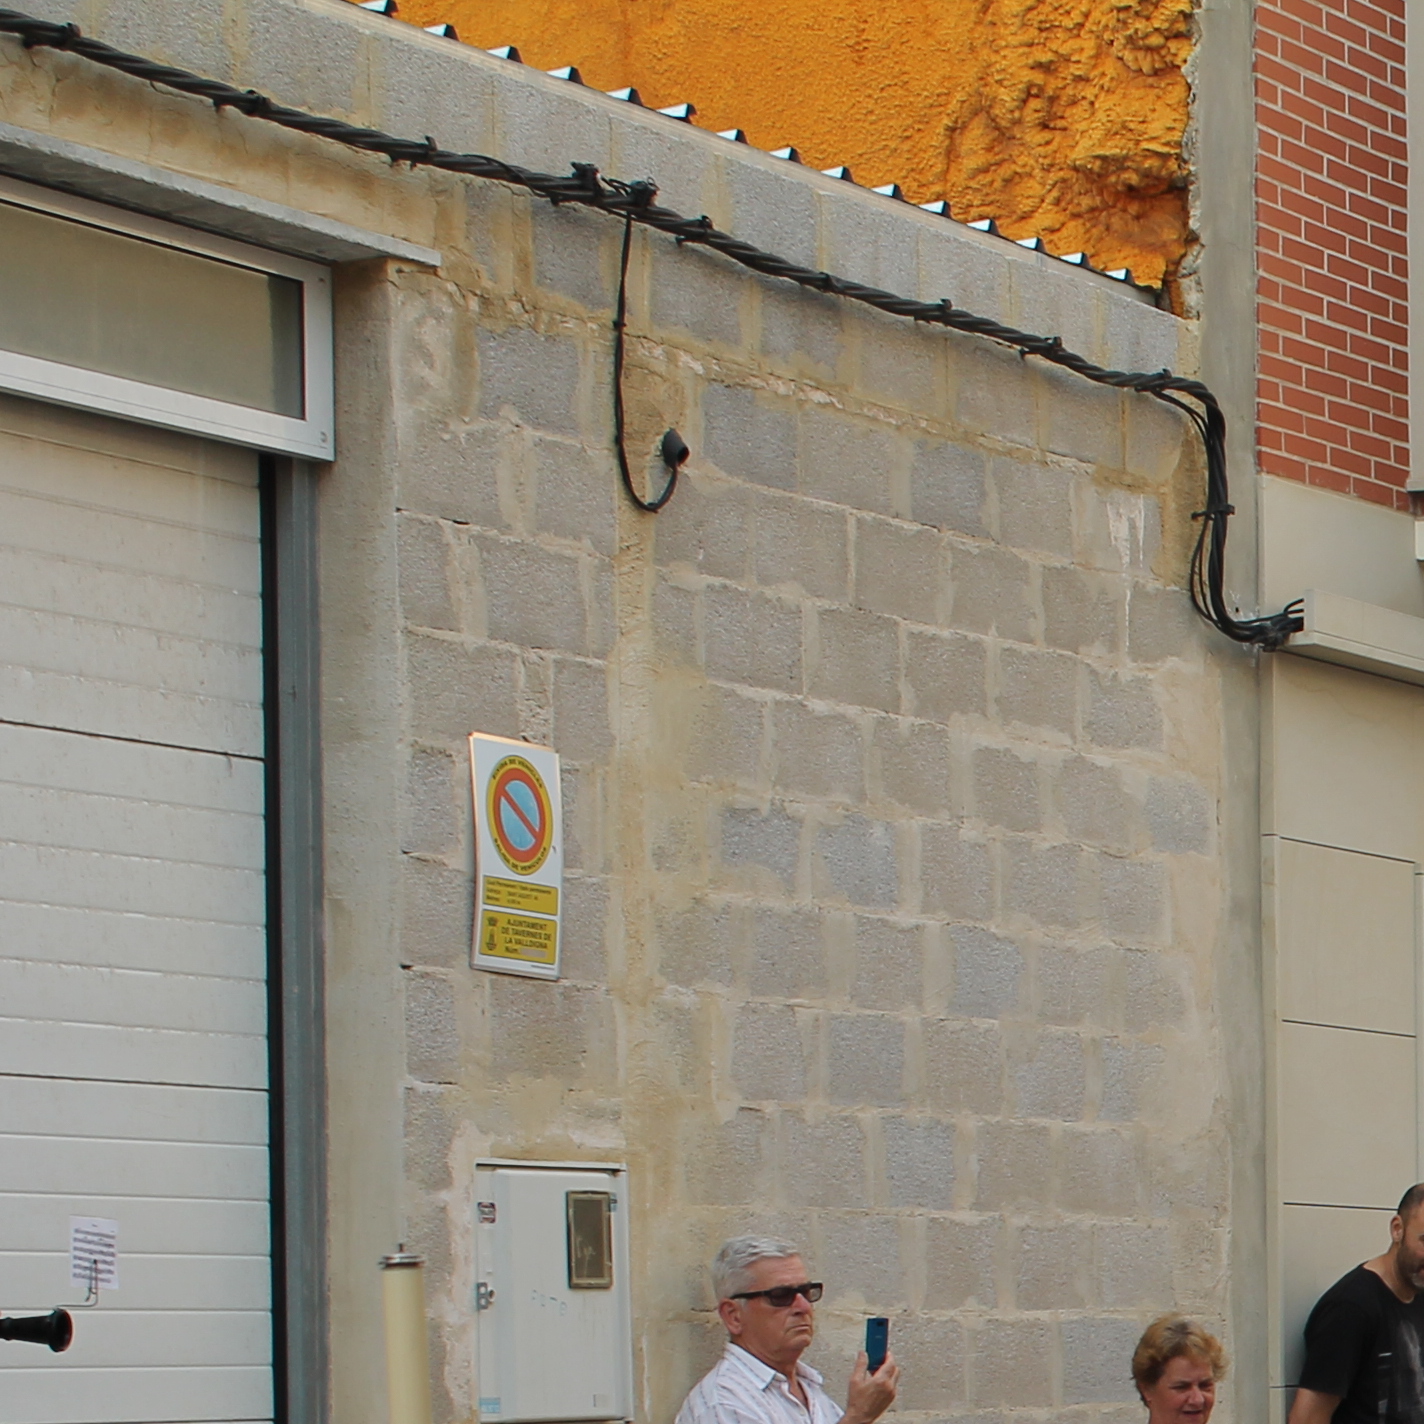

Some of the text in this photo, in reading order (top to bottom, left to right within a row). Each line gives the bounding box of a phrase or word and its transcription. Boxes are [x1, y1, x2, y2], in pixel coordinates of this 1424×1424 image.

[507, 918, 547, 930] AJUNTAMENT
[501, 926, 552, 941] DE TAVERNES DE
[505, 936, 548, 949] LA VALLDIGNA
